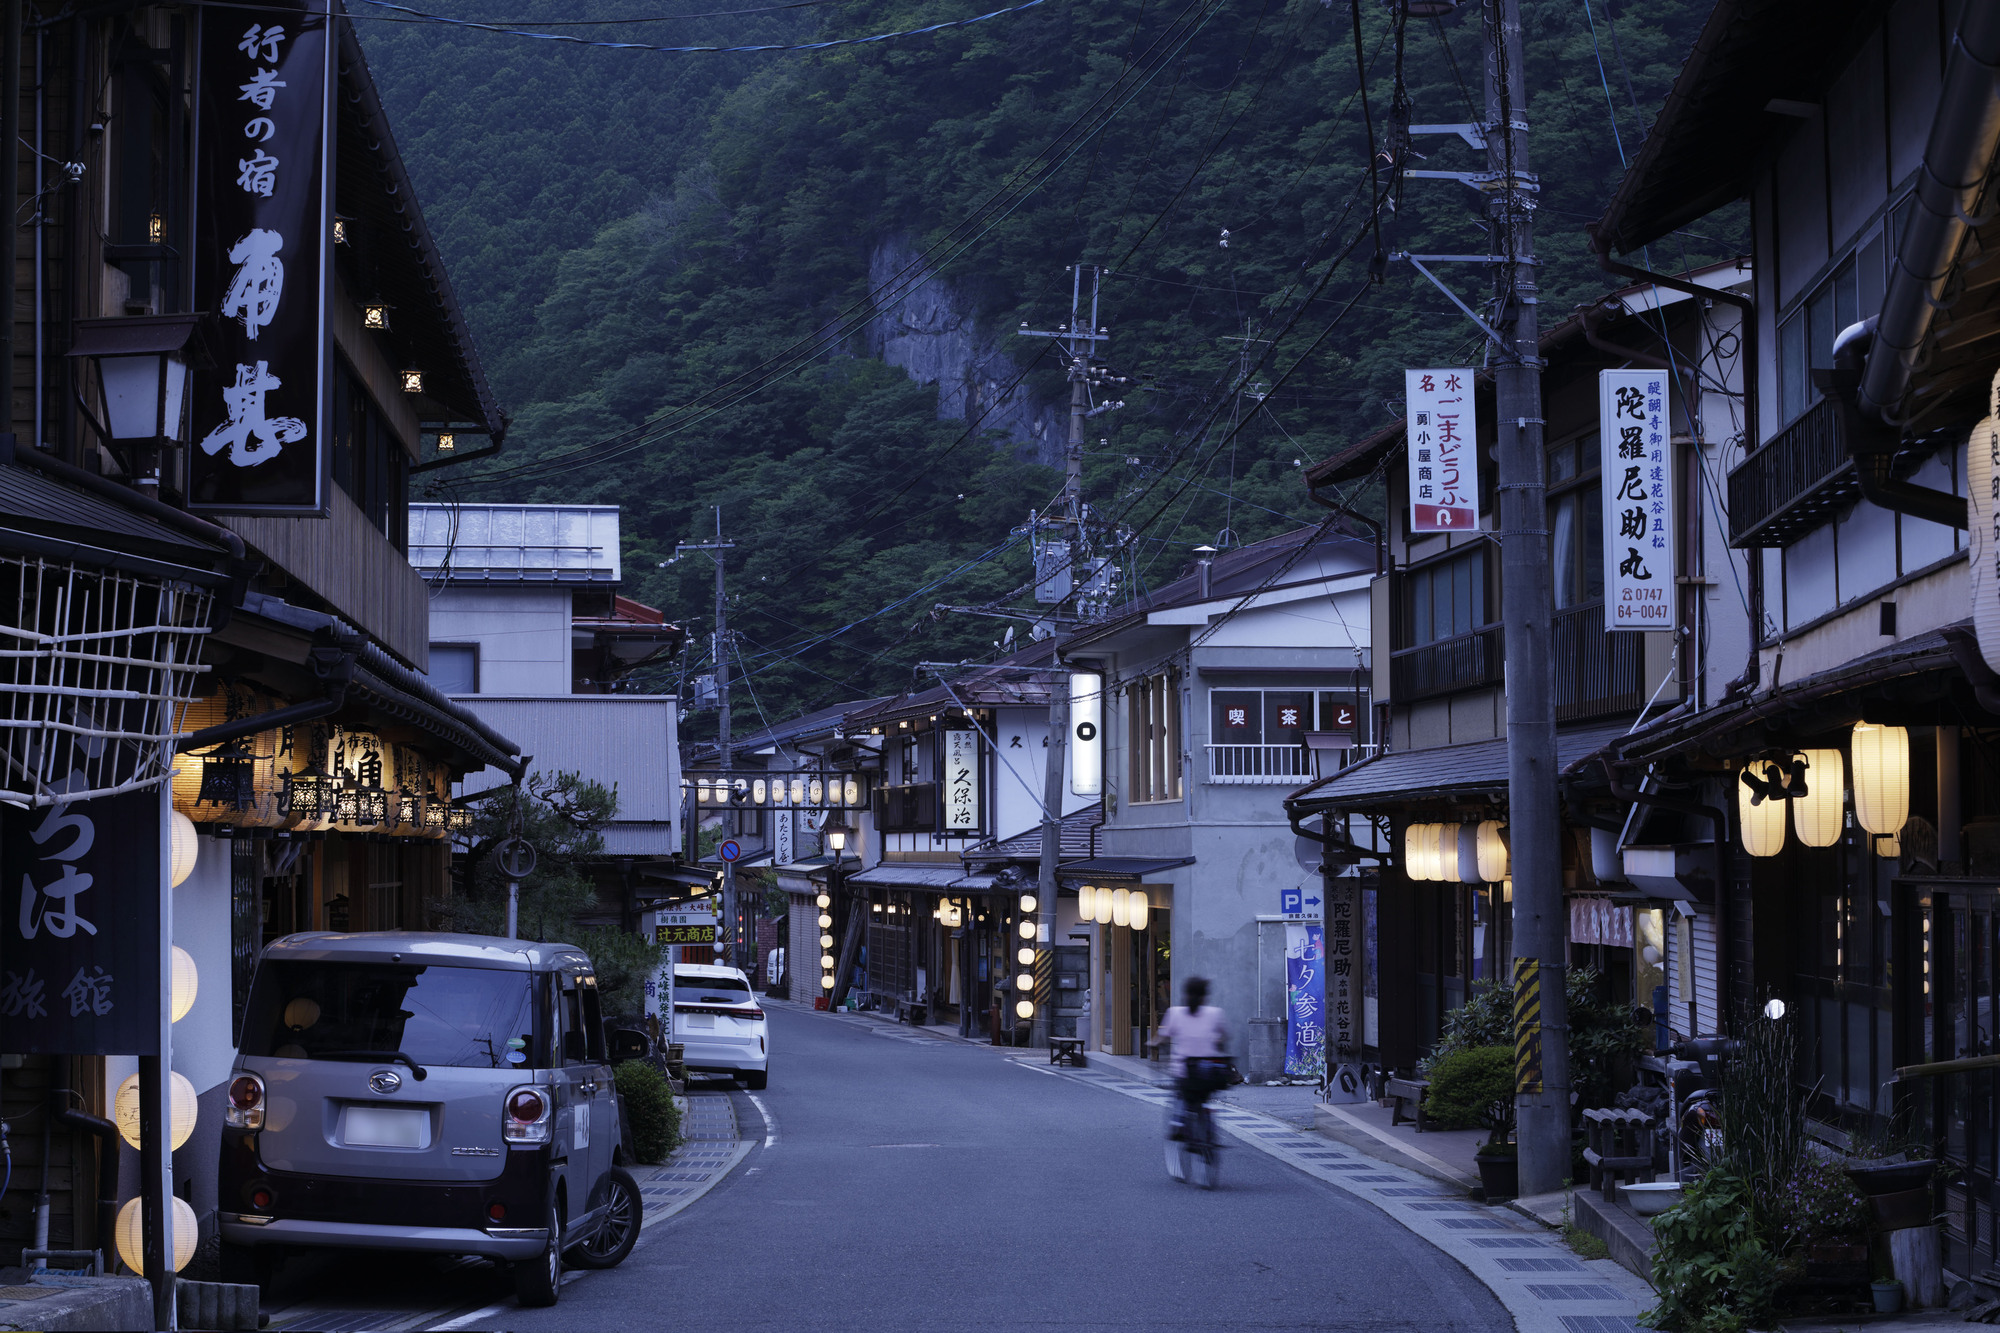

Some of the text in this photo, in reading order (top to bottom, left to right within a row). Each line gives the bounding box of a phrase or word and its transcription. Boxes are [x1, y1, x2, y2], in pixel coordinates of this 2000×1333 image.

[236, 23, 287, 199] 行者の宿
[1418, 373, 1463, 393] 名水
[1436, 396, 1469, 506] ごまどうふ
[1646, 381, 1666, 549] 醍醐寺御用達花谷丑松
[1614, 386, 1653, 581] 陀羅尼助丸
[1618, 604, 1668, 619] 64-0047
[1635, 588, 1663, 601] 0747
[953, 767, 972, 824] 久保治
[778, 812, 790, 863] あたらし屋
[1285, 894, 1300, 910] P
[657, 926, 715, 942] 辻元商店
[1332, 902, 1352, 977] 陀羅尼助
[0, 965, 115, 1019] 旅館
[1293, 938, 1319, 1047] 七夕参道
